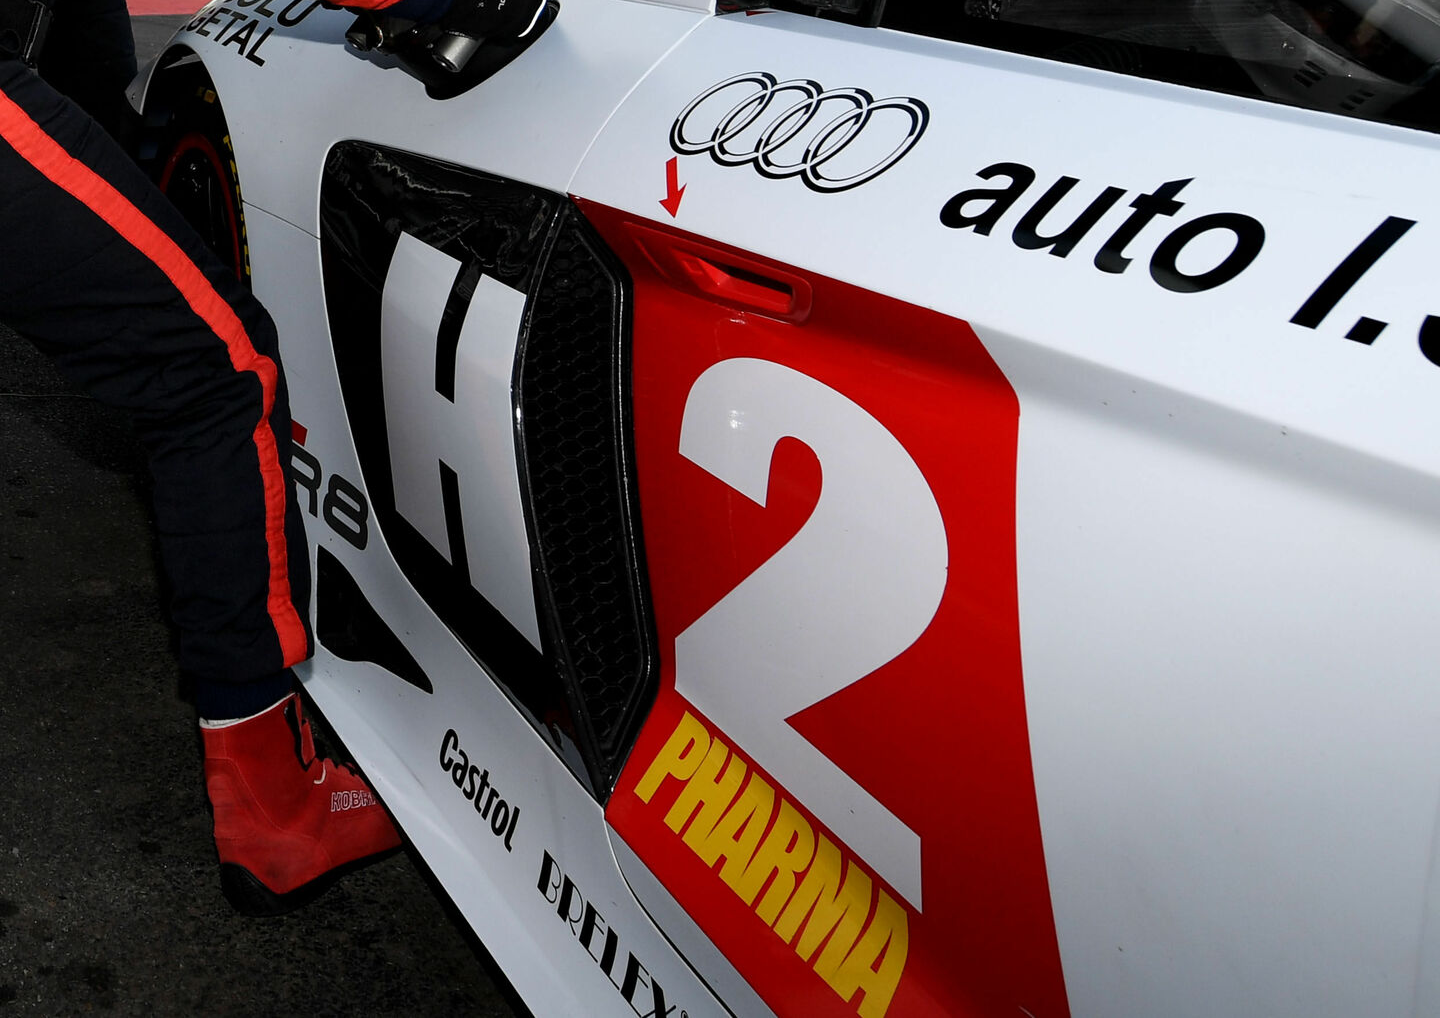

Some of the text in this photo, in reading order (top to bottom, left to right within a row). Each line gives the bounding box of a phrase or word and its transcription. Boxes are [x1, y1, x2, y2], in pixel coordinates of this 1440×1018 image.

[179, 6, 275, 68] GETAL
[939, 161, 1440, 368] auto I.
[290, 440, 368, 551] R8
[439, 728, 521, 853] Castrol
[633, 710, 909, 1018] PHARMA
